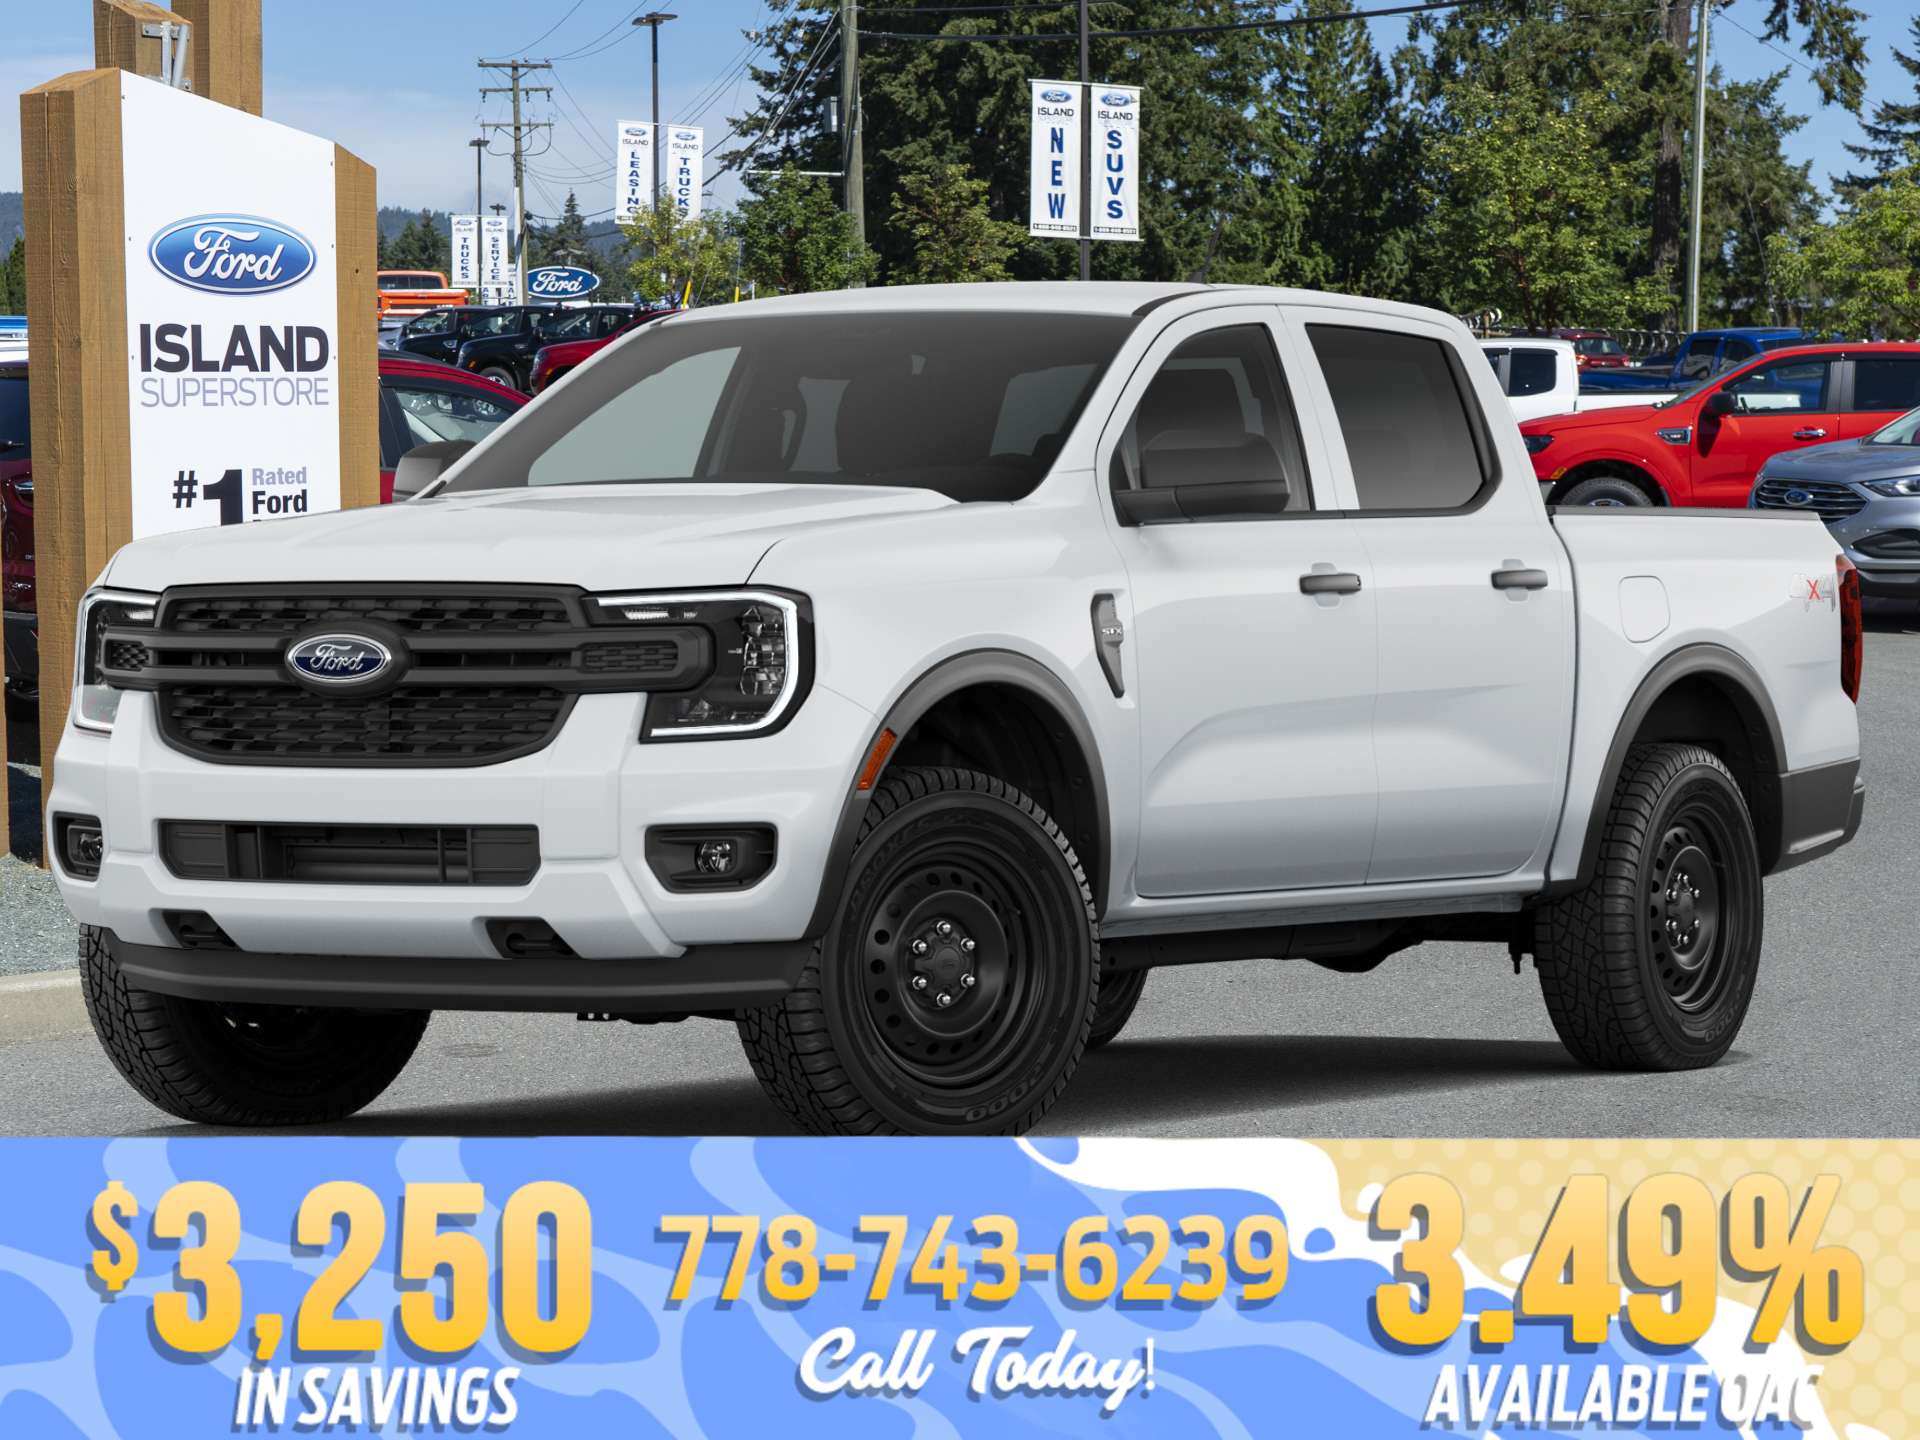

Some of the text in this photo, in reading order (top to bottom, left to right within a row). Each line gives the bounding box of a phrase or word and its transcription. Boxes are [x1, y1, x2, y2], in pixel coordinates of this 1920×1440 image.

[1038, 107, 1074, 117] ISLAND
[1098, 110, 1133, 121] ISLAND
[1048, 127, 1065, 219] NEW
[1106, 129, 1124, 219] SUVS
[184, 226, 283, 281] Ford
[460, 237, 469, 279] TRUCKS
[491, 237, 499, 280] SERVICE
[532, 271, 583, 292] Ford
[139, 323, 329, 373] ISLAND
[140, 377, 330, 407] SUPERSTORE
[252, 466, 307, 486] Rated
[172, 468, 243, 526] #1
[252, 489, 307, 514] Ford
[309, 643, 365, 671] Ford
